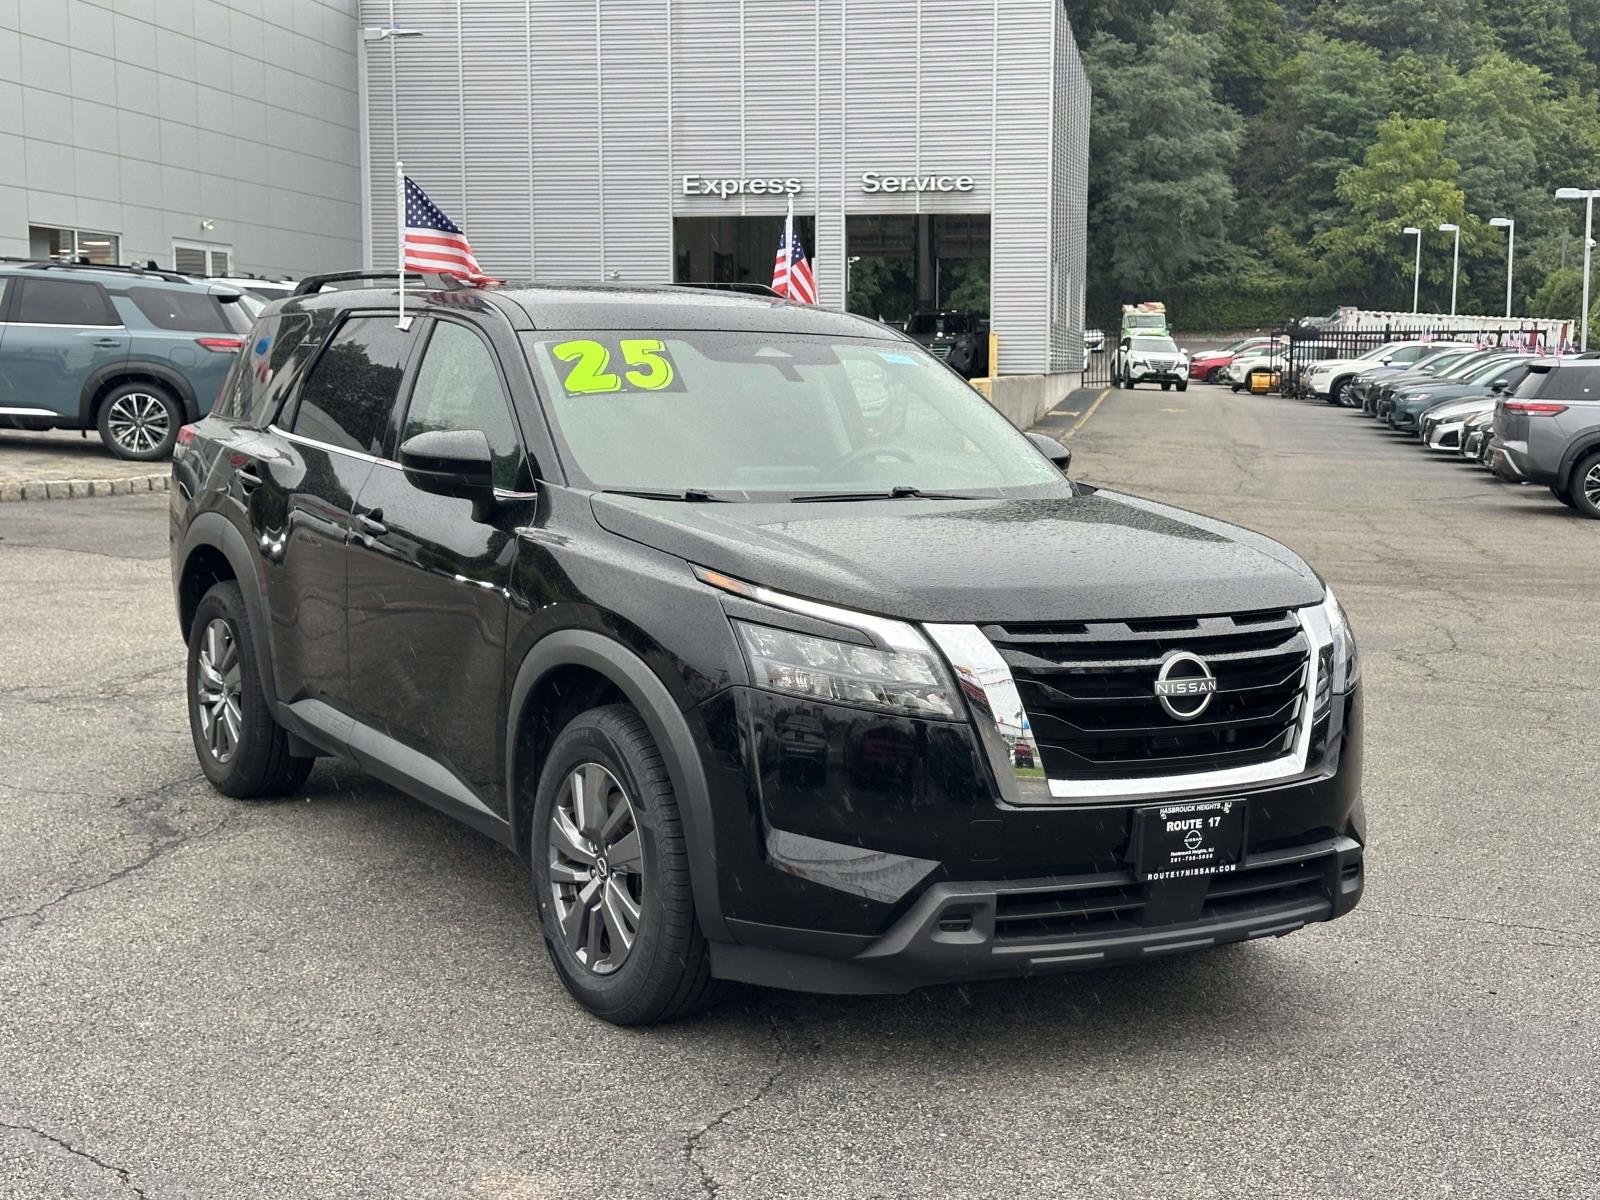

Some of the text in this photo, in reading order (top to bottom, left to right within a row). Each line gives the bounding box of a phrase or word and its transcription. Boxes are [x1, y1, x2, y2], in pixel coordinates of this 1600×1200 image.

[681, 171, 975, 199] Express Service
[553, 339, 674, 393] 25
[1156, 681, 1216, 694] NISSAN
[1160, 805, 1196, 815] HASBROUCK
[1166, 817, 1221, 832] ROUTE 17
[1147, 864, 1236, 880] ROUTE17NISSAN.COM
